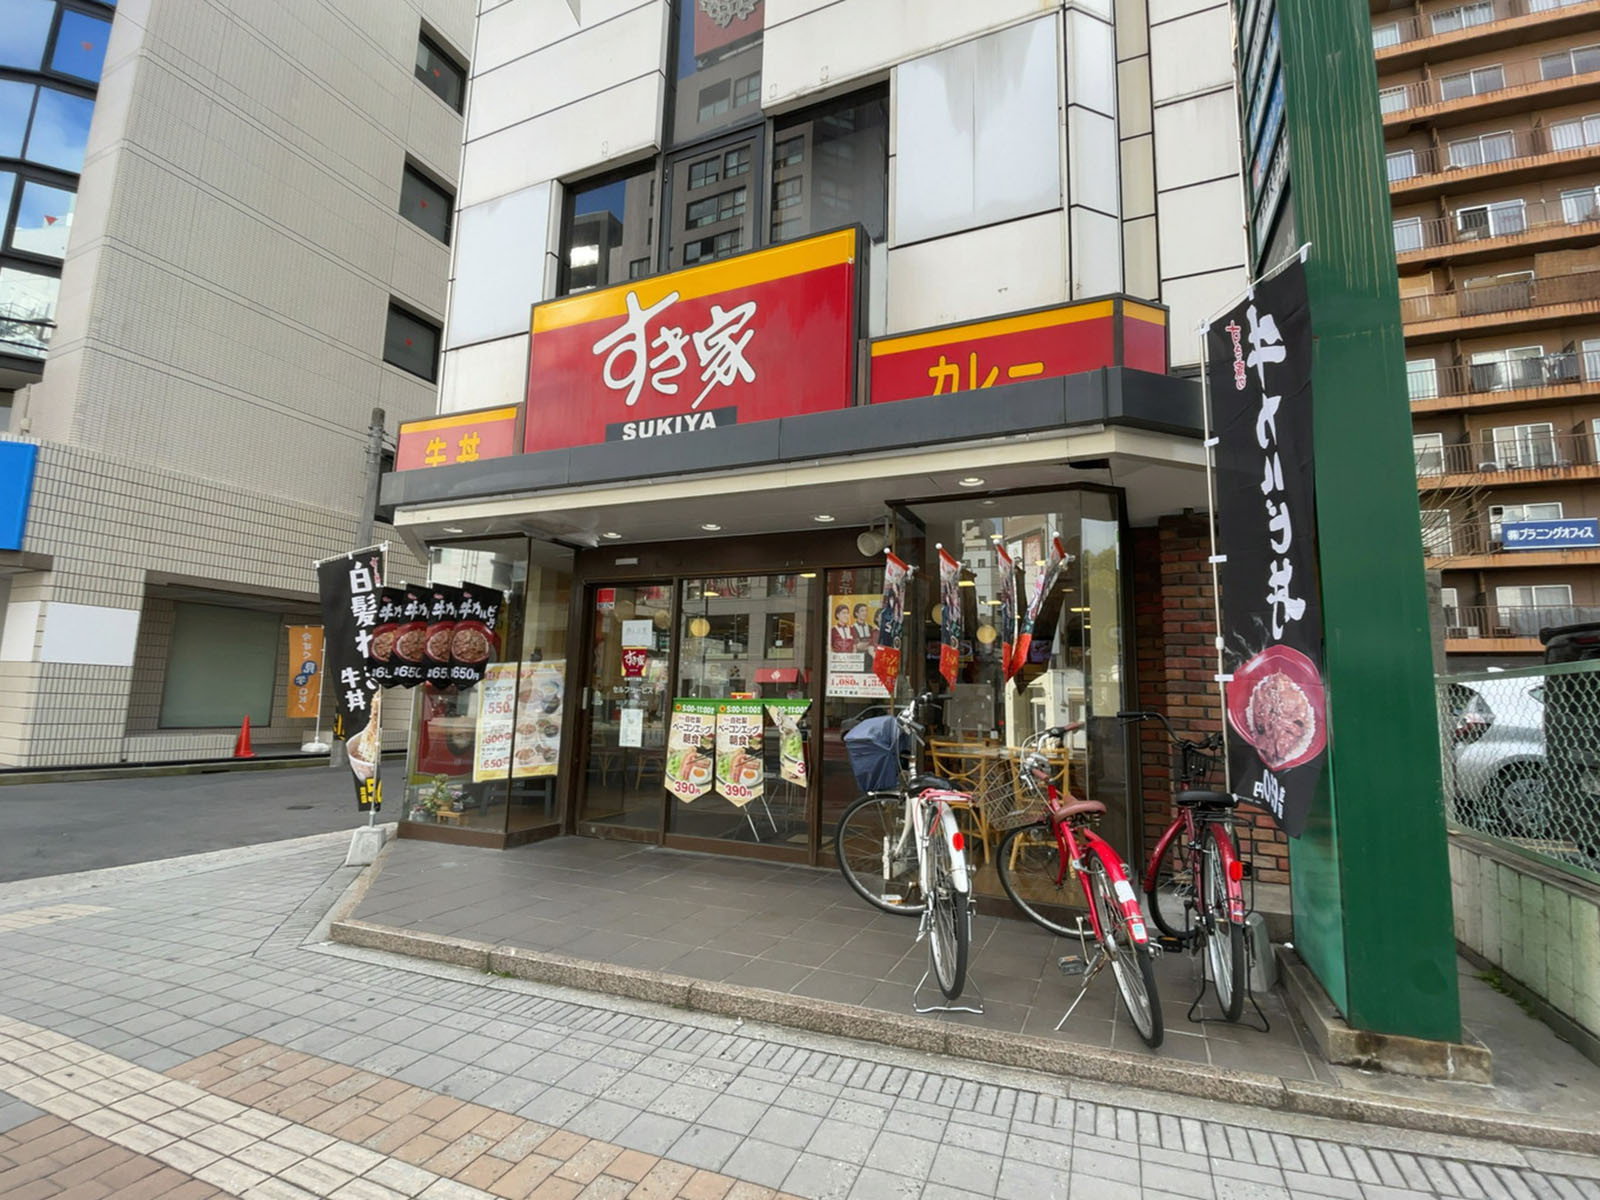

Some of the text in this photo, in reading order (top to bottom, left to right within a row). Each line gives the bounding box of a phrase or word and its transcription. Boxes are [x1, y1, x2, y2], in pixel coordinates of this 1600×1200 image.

[592, 290, 757, 409] すき家
[928, 352, 1044, 396] カレー
[622, 411, 717, 440] SUKIYA
[424, 431, 481, 467] 牛丼
